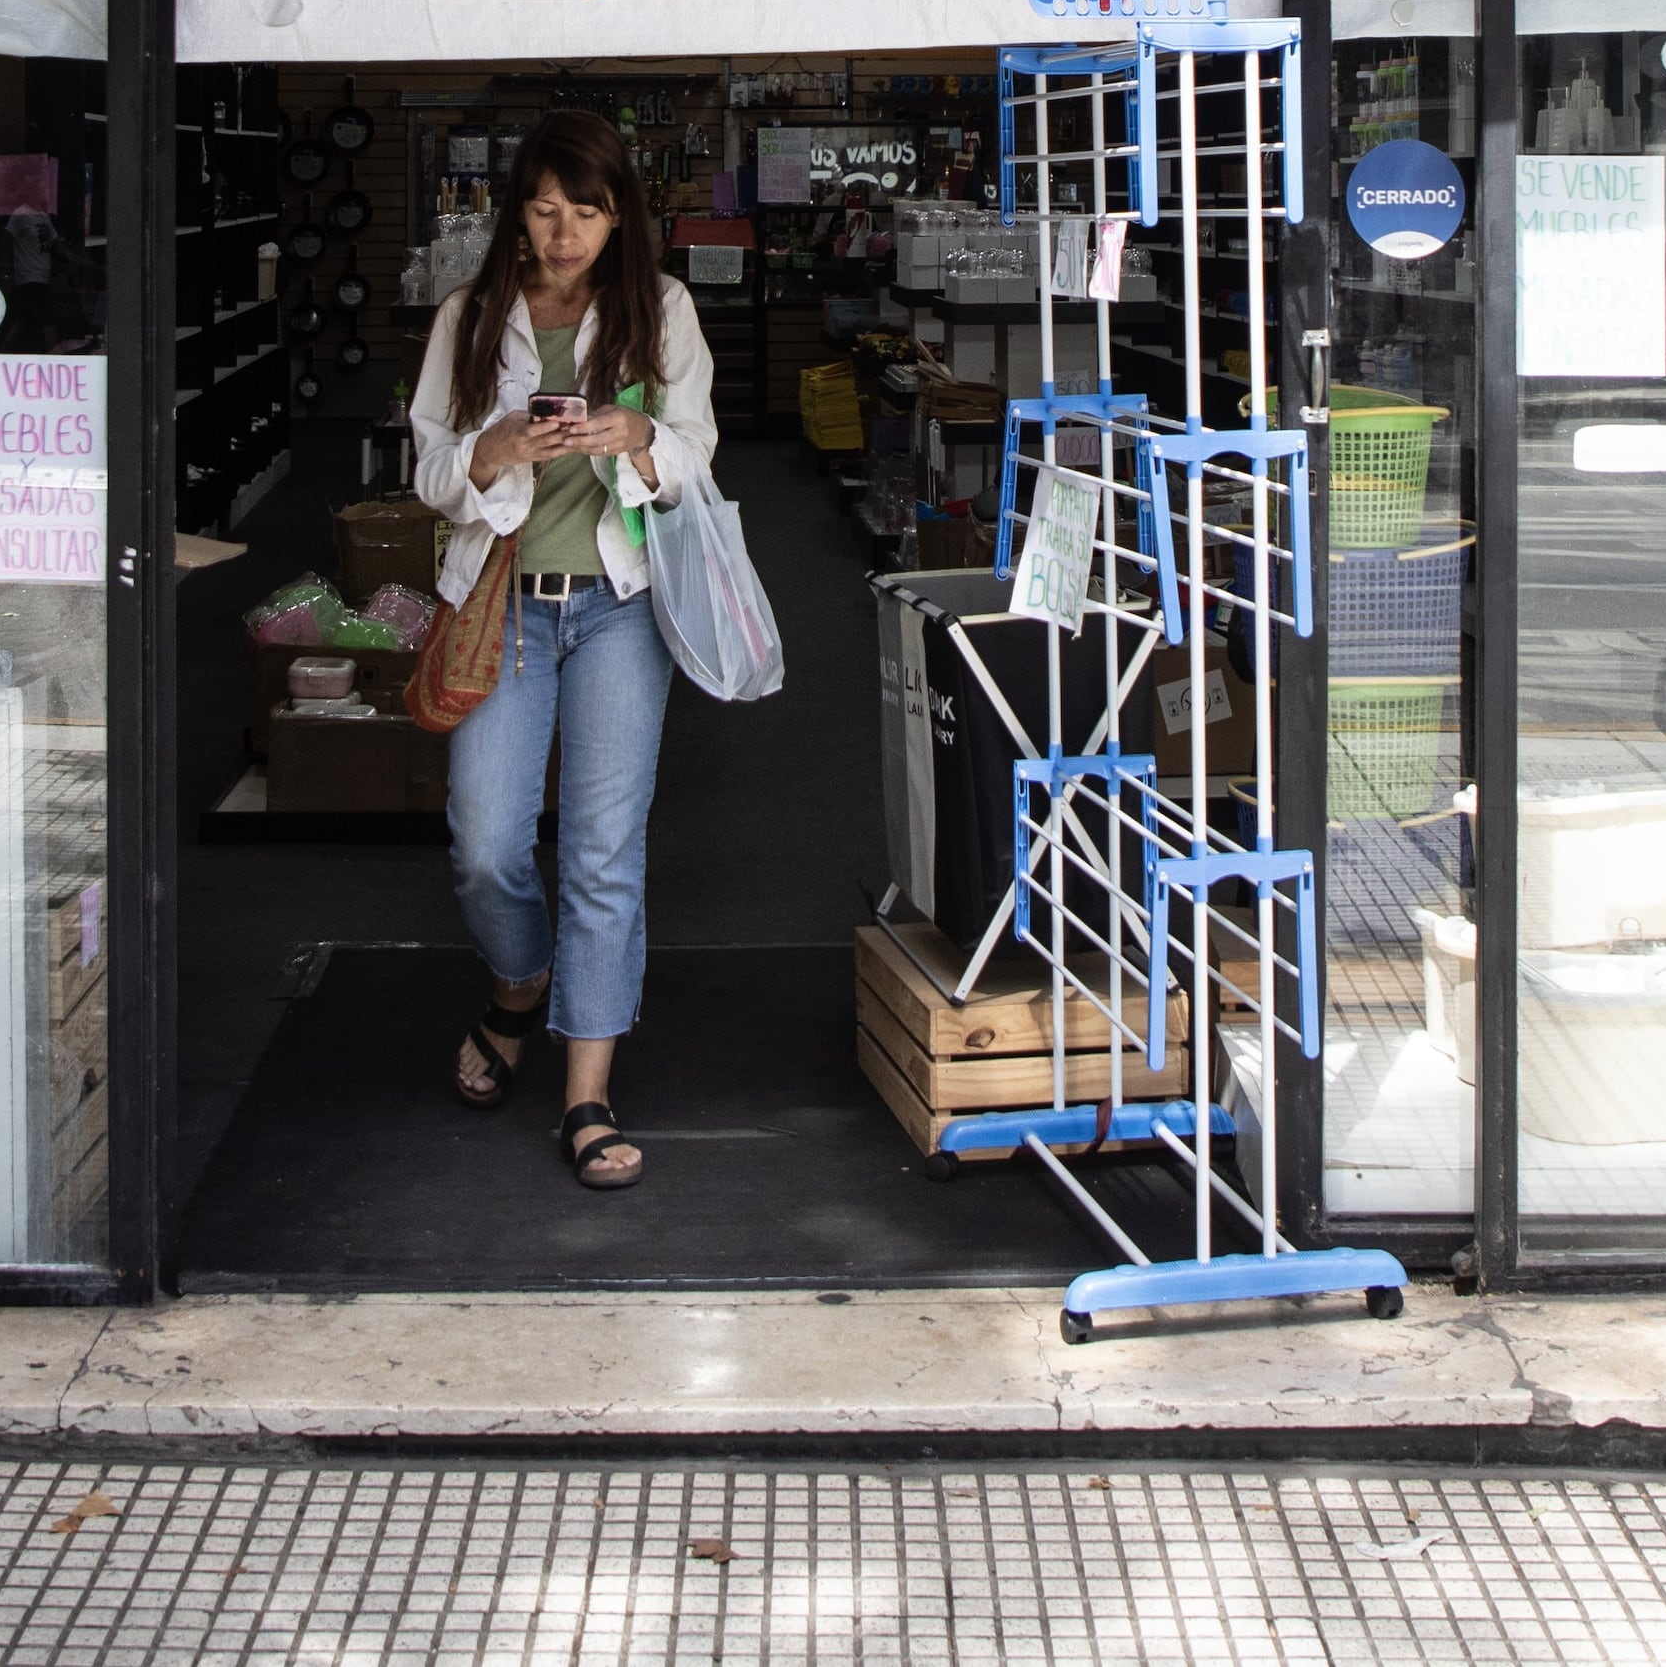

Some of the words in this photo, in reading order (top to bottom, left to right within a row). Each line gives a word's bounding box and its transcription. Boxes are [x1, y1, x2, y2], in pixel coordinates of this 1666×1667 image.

[846, 139, 917, 165] VAMOS
[1362, 188, 1451, 205] CERRADO
[1518, 159, 1554, 197] SE
[1560, 162, 1647, 202] VENDE
[1516, 209, 1645, 252] MUEBLES
[1, 361, 89, 402] VENDE
[20, 456, 37, 479] Y
